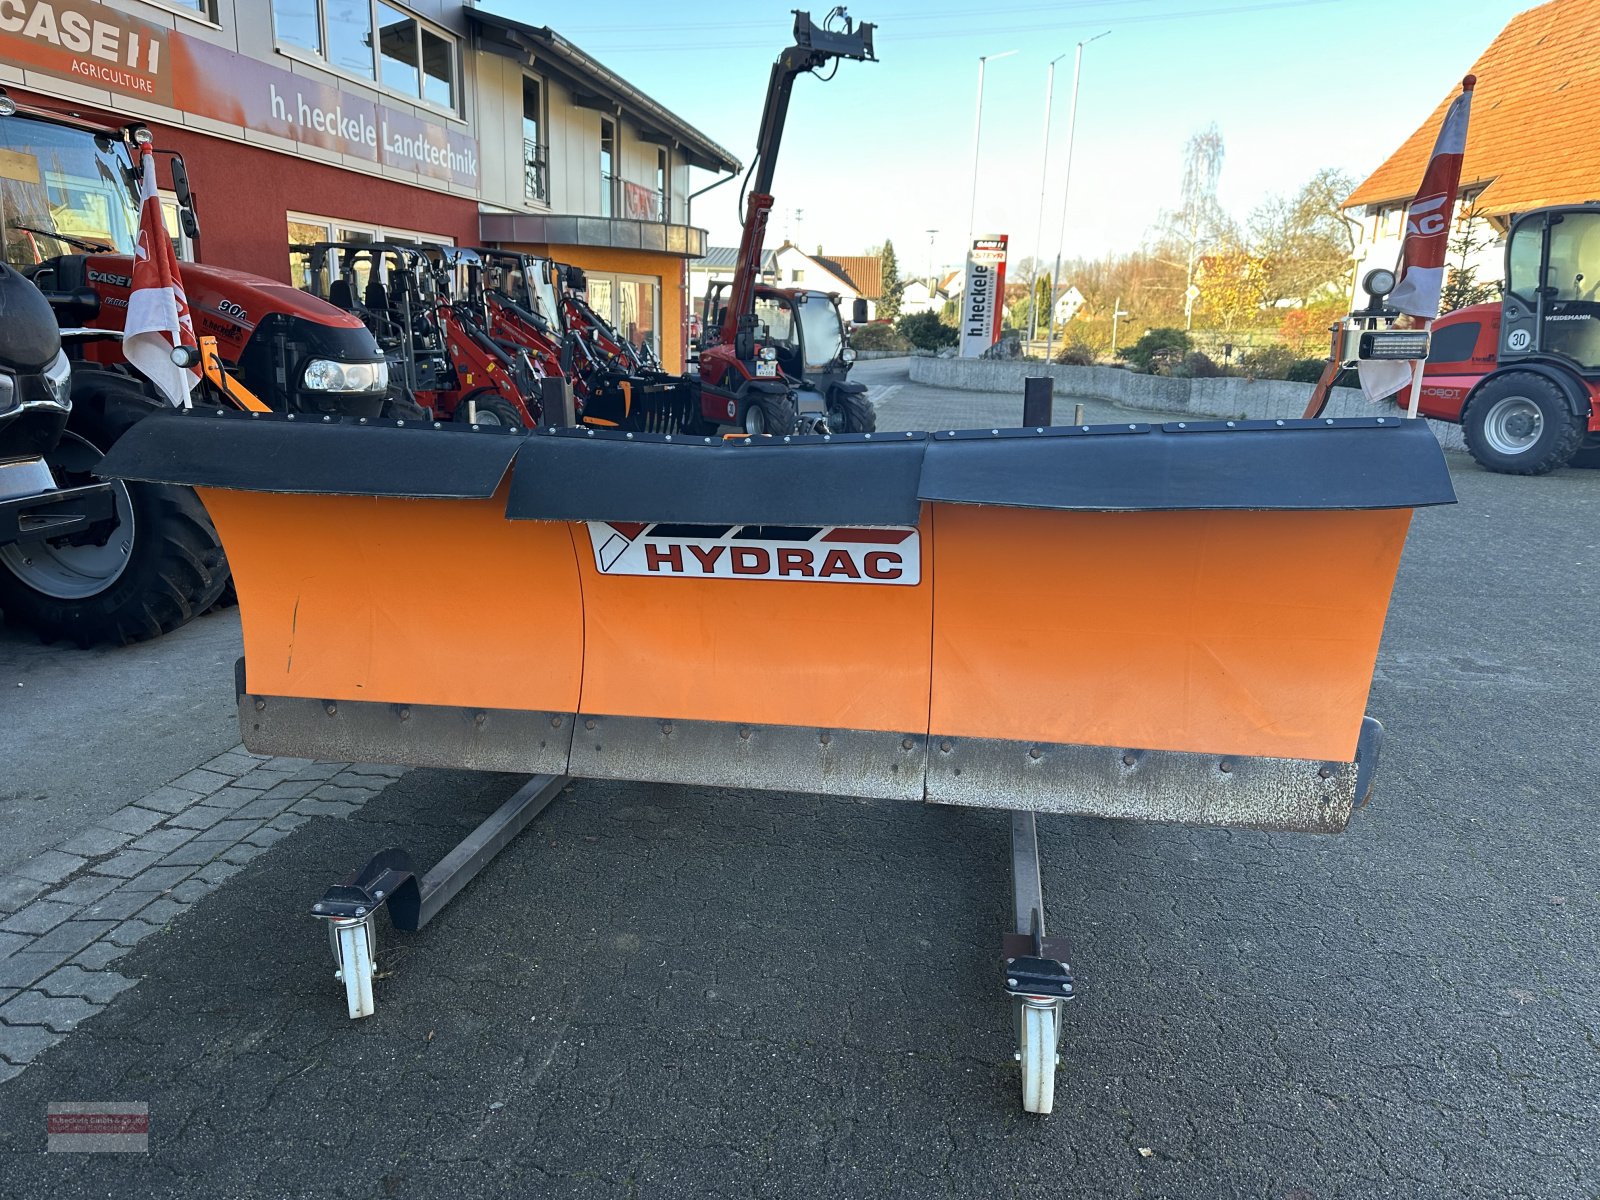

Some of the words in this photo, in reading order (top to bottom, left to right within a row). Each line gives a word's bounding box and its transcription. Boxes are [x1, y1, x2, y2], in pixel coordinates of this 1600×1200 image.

[0, 0, 120, 62] CASE
[71, 59, 153, 93] AGRICULTURE
[382, 121, 477, 177] Landtechnik
[974, 252, 1004, 260] STEYR
[87, 270, 126, 287] CASE
[218, 300, 247, 320] 90A
[1511, 333, 1526, 346] 30
[644, 543, 904, 581] HYDRAC
